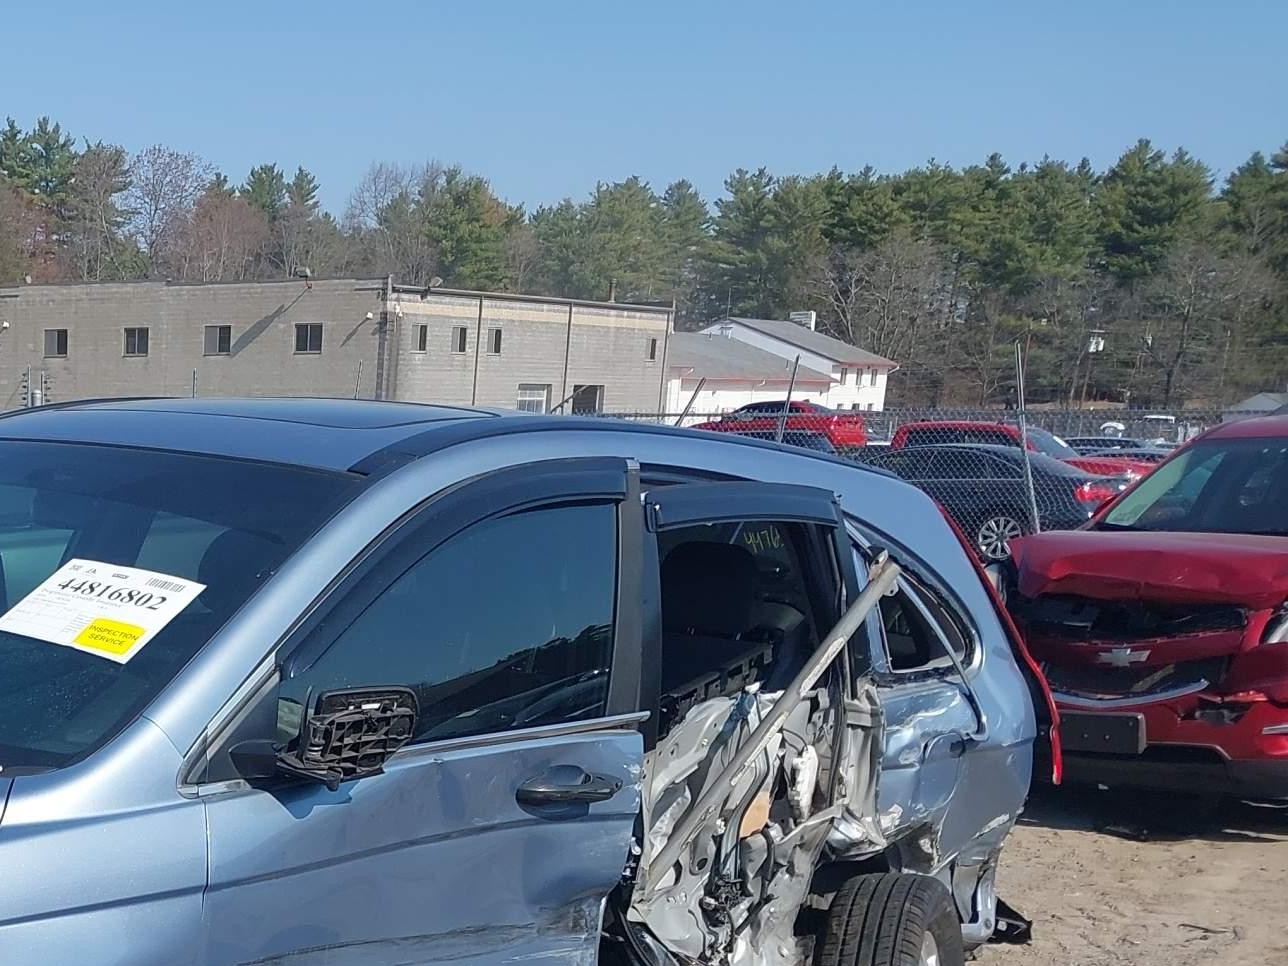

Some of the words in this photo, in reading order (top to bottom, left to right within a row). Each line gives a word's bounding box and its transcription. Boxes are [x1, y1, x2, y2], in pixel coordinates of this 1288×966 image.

[57, 577, 168, 611] 44816802
[87, 633, 127, 647] SERVICE
[88, 624, 140, 641] INSPECTION
